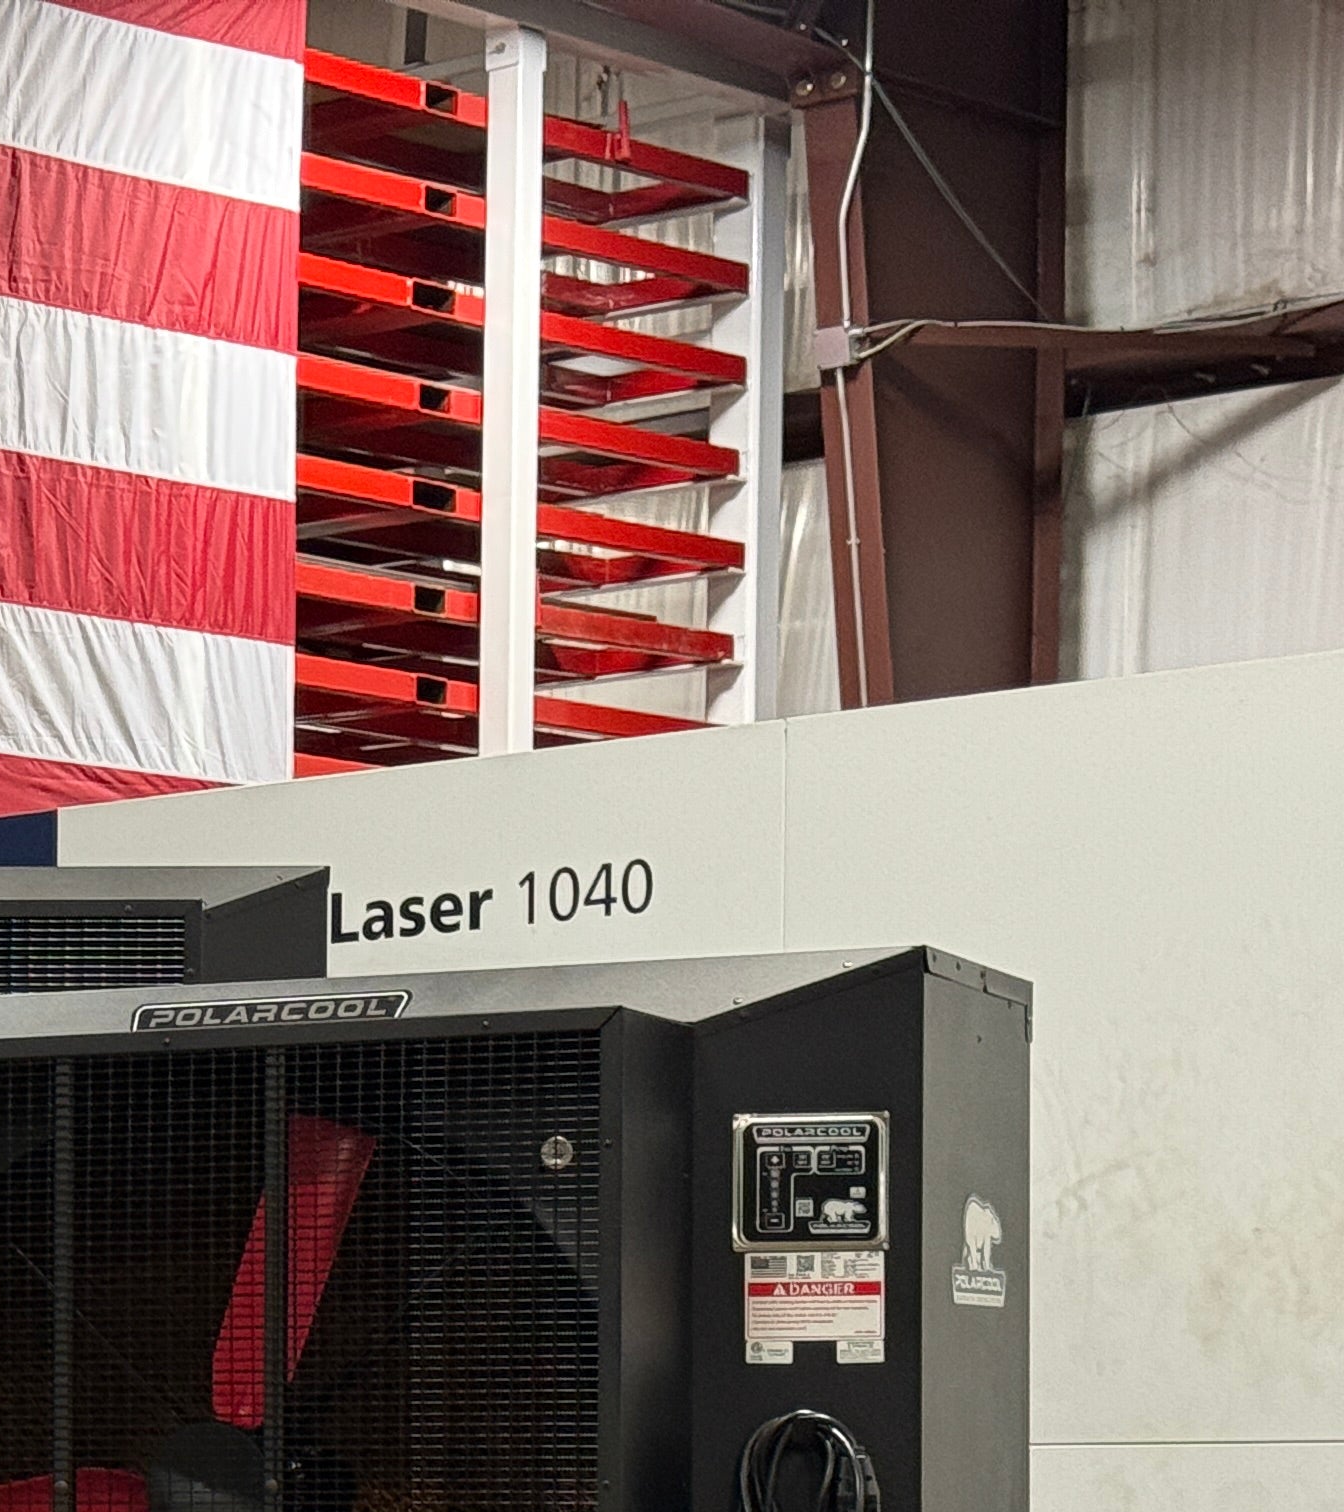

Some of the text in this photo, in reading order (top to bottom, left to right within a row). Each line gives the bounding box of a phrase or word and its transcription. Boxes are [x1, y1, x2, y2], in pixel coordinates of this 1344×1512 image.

[330, 858, 654, 945] Laser 1040
[148, 998, 388, 1028] POLARCOOL
[761, 1127, 862, 1137] POLARCOOL
[789, 1282, 856, 1296] DANGER
